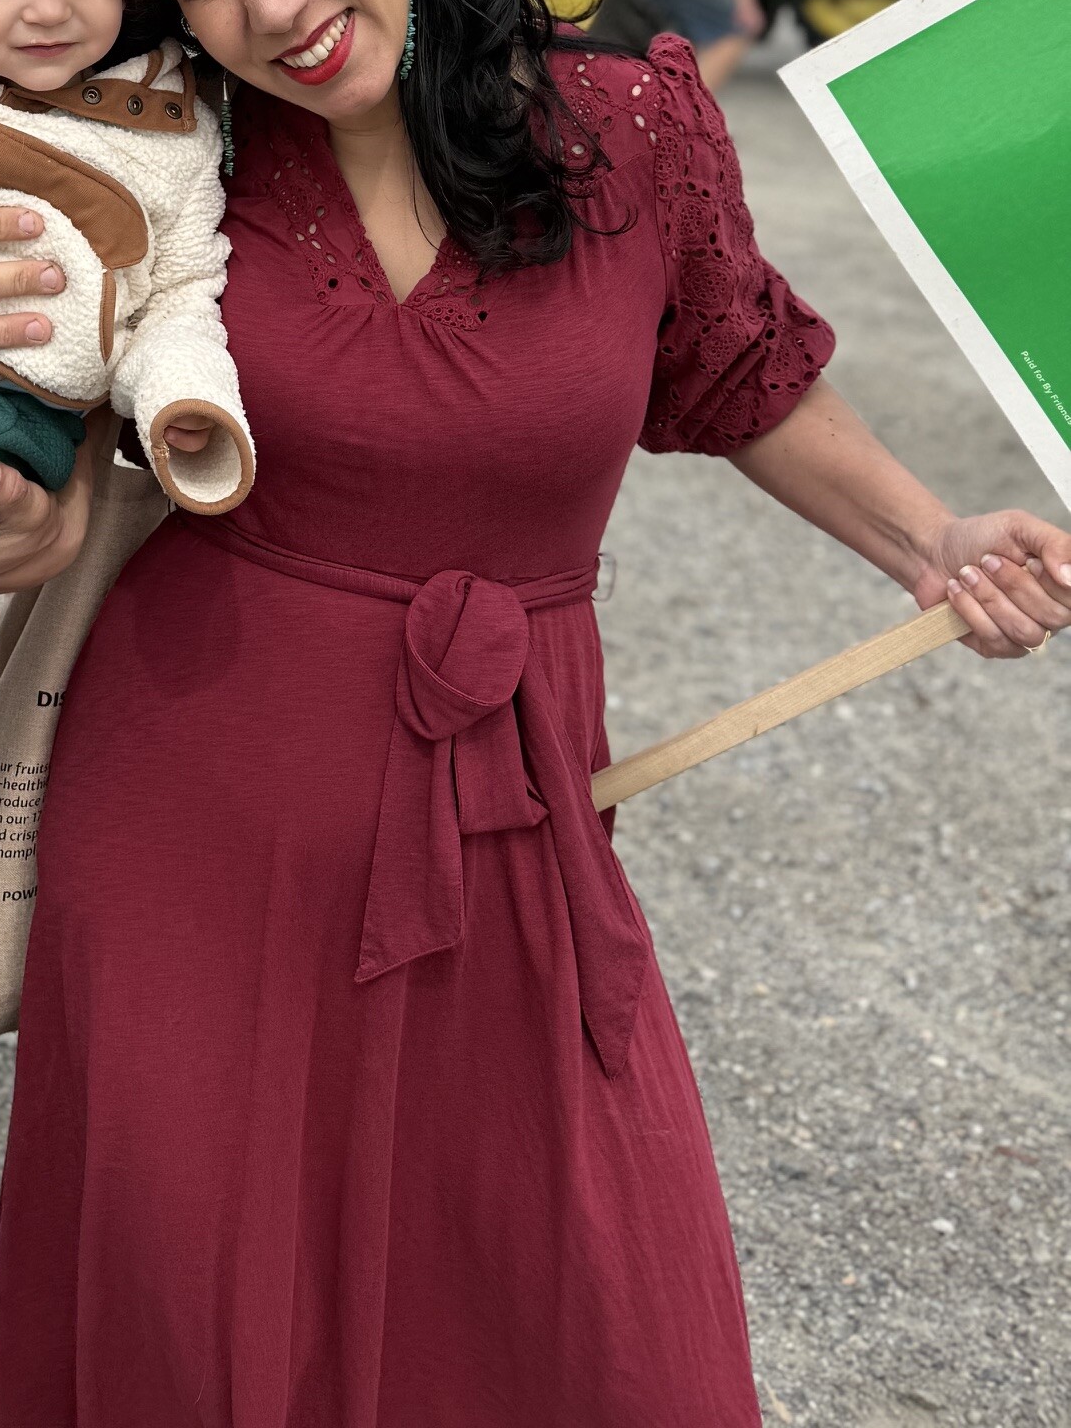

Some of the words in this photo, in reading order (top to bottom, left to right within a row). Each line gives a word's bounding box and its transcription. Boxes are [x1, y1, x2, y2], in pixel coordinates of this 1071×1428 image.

[1021, 350, 1037, 369] Paid
[1033, 369, 1045, 382] for
[1042, 382, 1053, 394] By
[6, 815, 29, 824] our
